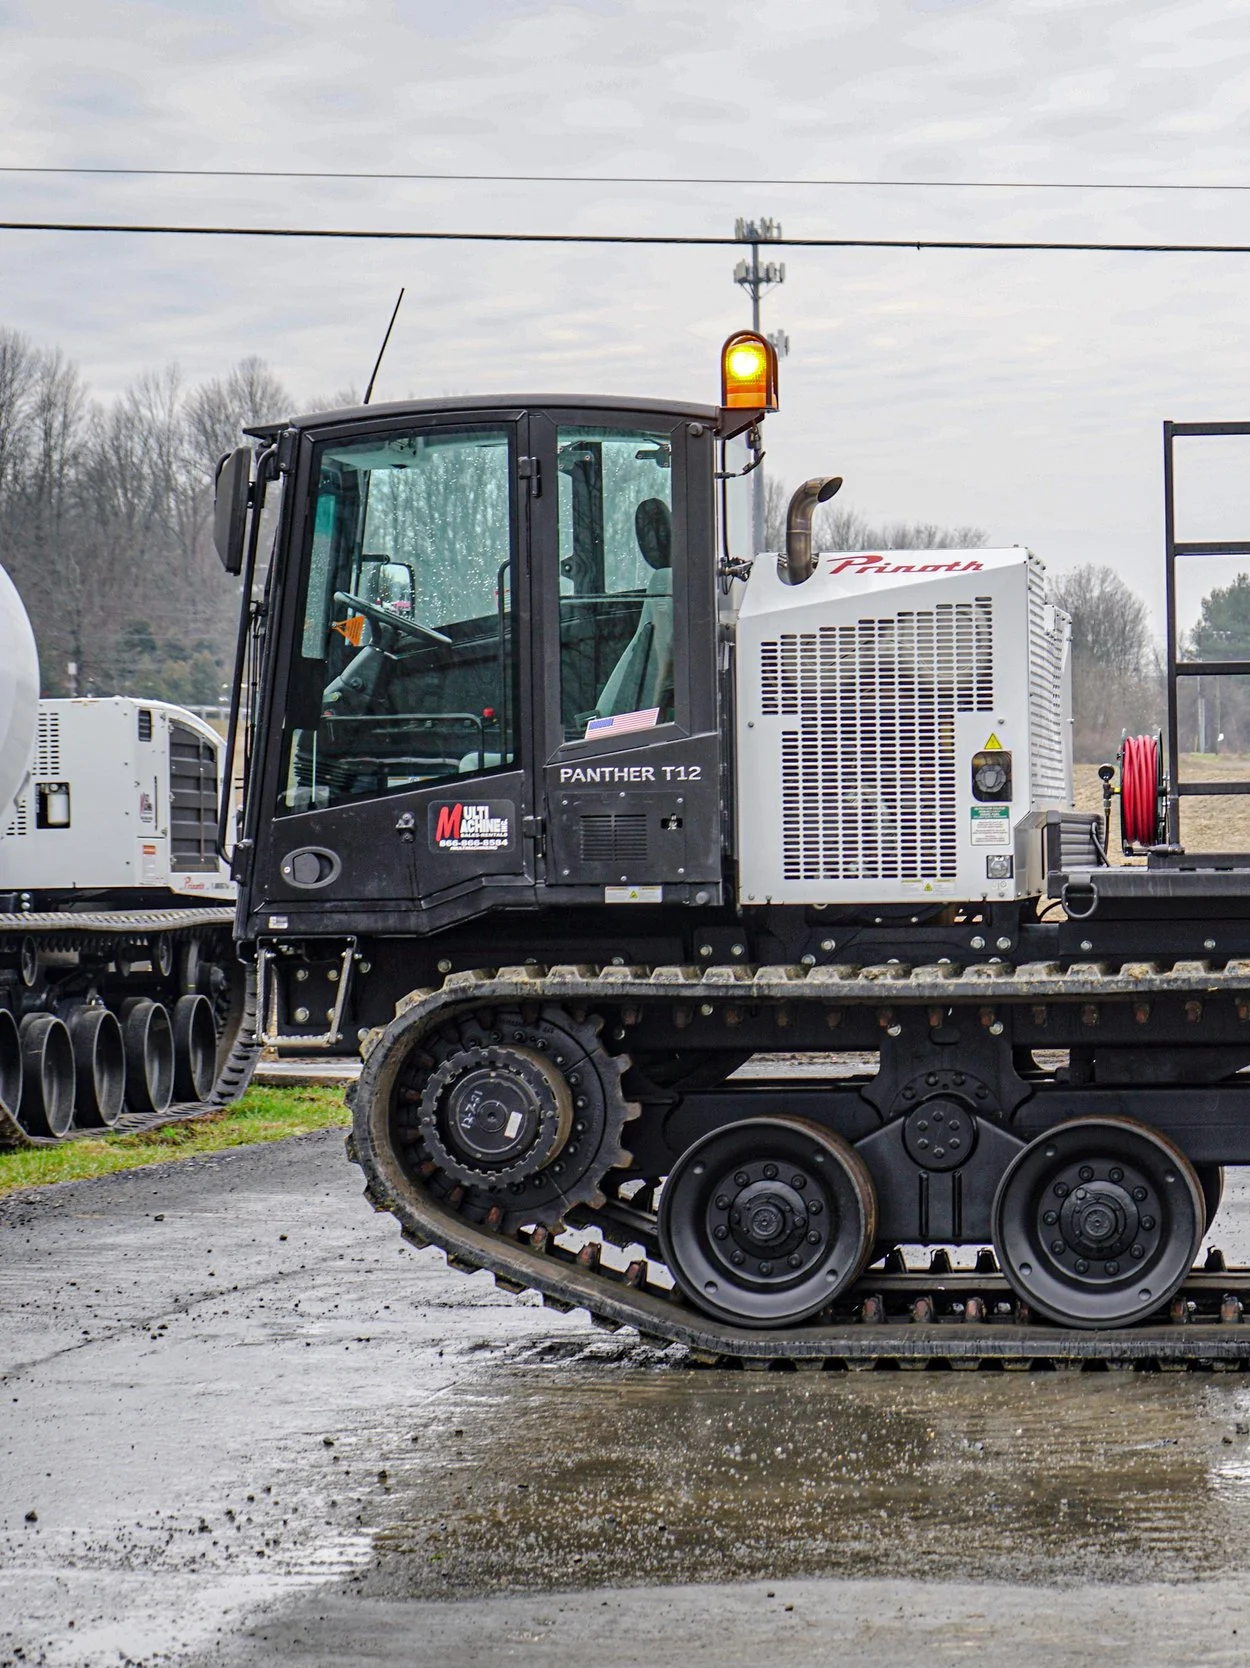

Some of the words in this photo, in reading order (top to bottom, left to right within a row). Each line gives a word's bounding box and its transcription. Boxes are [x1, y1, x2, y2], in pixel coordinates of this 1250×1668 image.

[826, 555, 984, 574] Prinoth
[560, 767, 655, 782] PANTHER
[661, 766, 701, 781] T12
